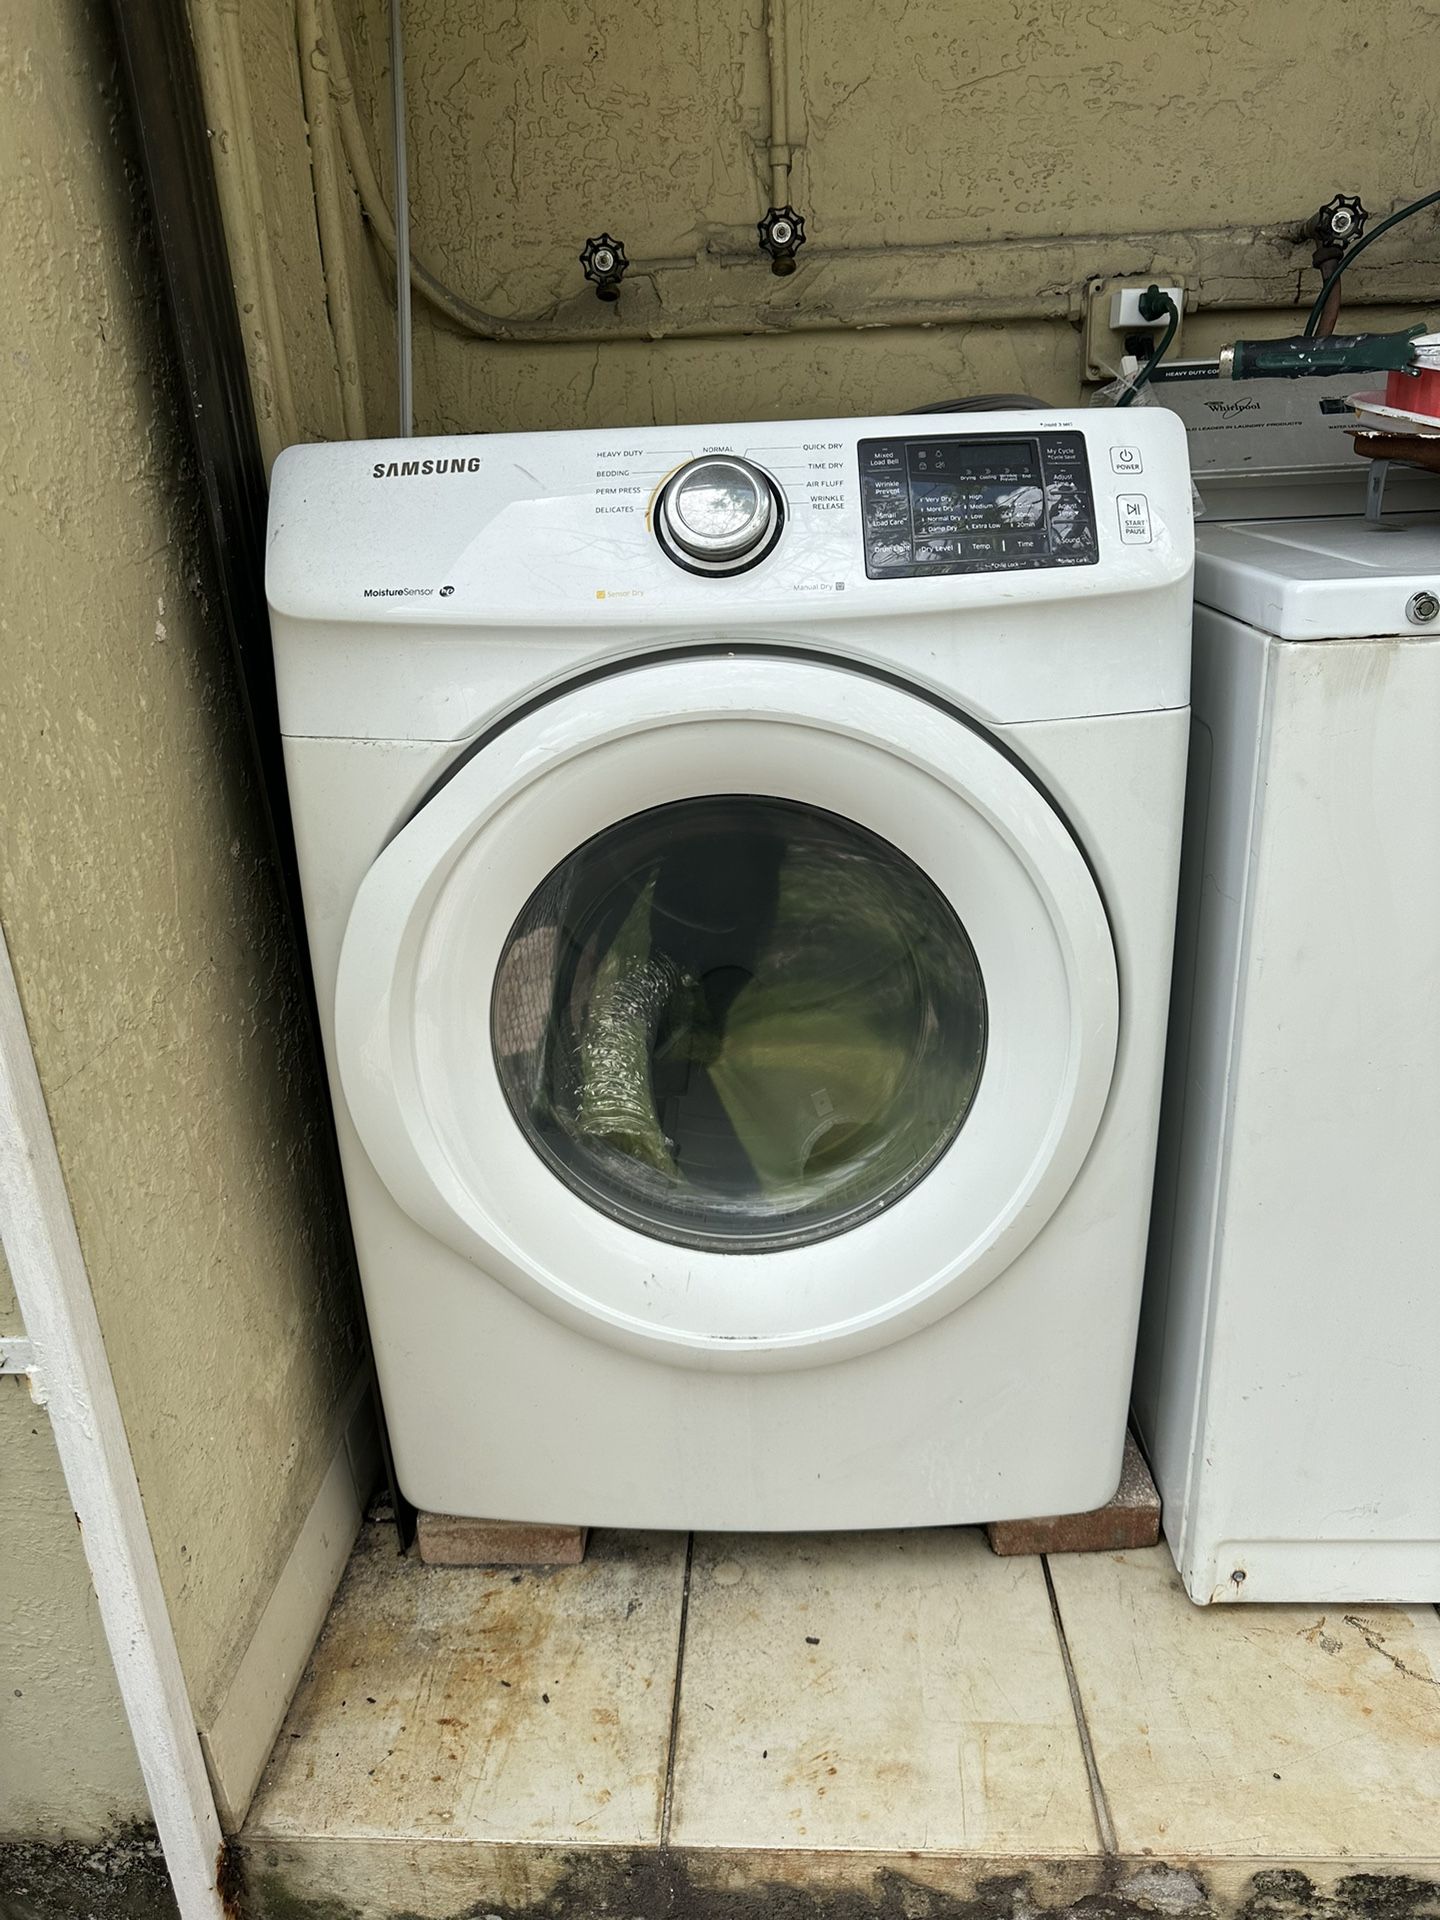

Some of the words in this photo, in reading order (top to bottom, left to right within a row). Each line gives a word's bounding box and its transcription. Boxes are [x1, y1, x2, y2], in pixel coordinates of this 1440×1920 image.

[1207, 400, 1261, 413] Whirlpool
[372, 457, 481, 478] SAMSUNG
[793, 583, 819, 591] Manual
[821, 583, 833, 591] Dry
[363, 588, 434, 597] MoistureSensor
[607, 590, 630, 598] Sensor
[632, 590, 644, 598] Dry
